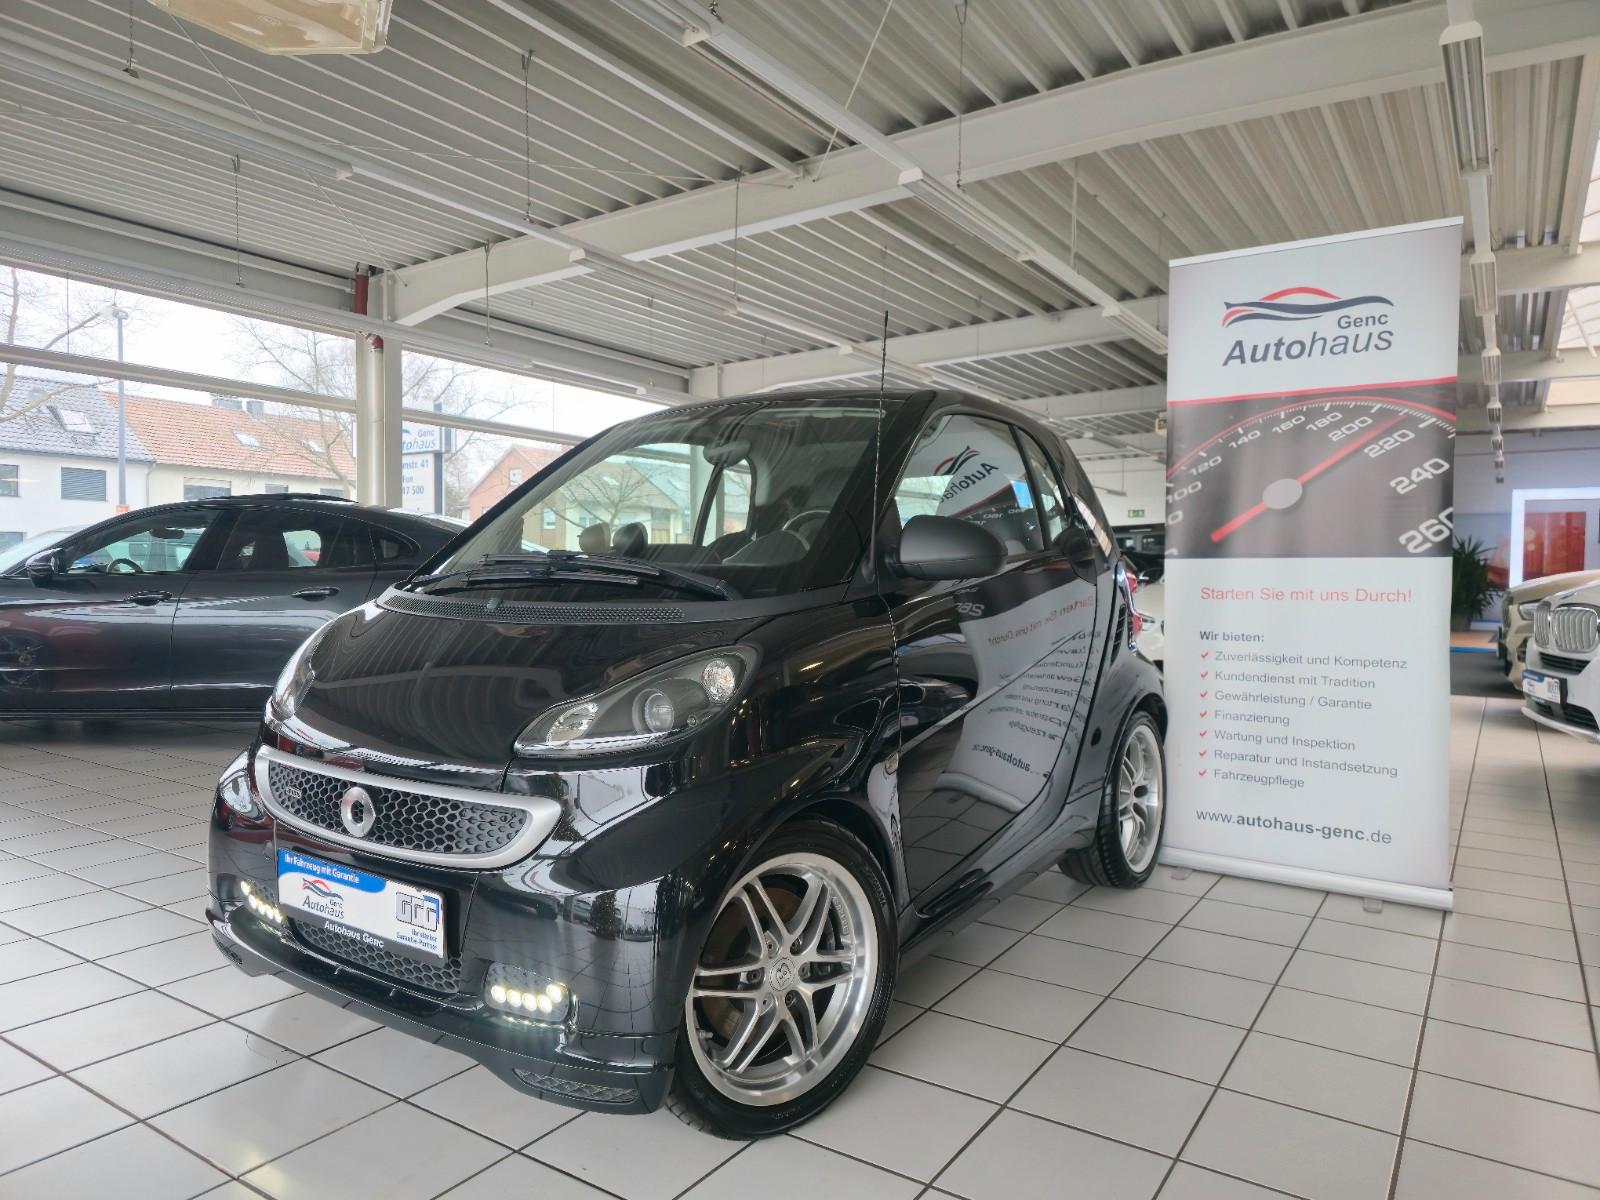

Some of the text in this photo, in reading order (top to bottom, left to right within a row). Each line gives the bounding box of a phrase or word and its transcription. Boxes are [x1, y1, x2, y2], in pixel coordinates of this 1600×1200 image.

[1337, 313, 1389, 329] Genc
[1221, 330, 1394, 367] Autohaus
[1271, 415, 1306, 433] 160
[1305, 411, 1343, 432] 180
[1328, 416, 1373, 441] 200
[402, 438, 436, 450] tohaus
[1228, 430, 1261, 449] 140
[1363, 428, 1415, 458] 220
[1188, 455, 1222, 476] 120
[1389, 457, 1450, 495] 240
[1167, 481, 1202, 503] 100
[1200, 587, 1413, 603] Starten Sie mit uns Durch!
[1199, 631, 1265, 643] Wir bieten:
[1215, 650, 1407, 671] Zuverlässigkeit und Kompetenz
[1215, 671, 1376, 689] Kundendienst mit Tradition
[1215, 690, 1306, 707] Gewährleistung
[1318, 696, 1373, 710] Garantie
[1214, 710, 1290, 727] Finanzierung
[1214, 730, 1356, 751] Wartung und Inspektion
[1214, 750, 1398, 778] Reparatur und Instandsetzung
[1214, 769, 1305, 789] Fahrzeugpflege
[1196, 809, 1392, 844] www.autohaus-genc.de
[293, 856, 321, 875] Fahrzeug
[302, 895, 345, 920] Autohaus
[324, 920, 385, 949] Autohaus Genc
